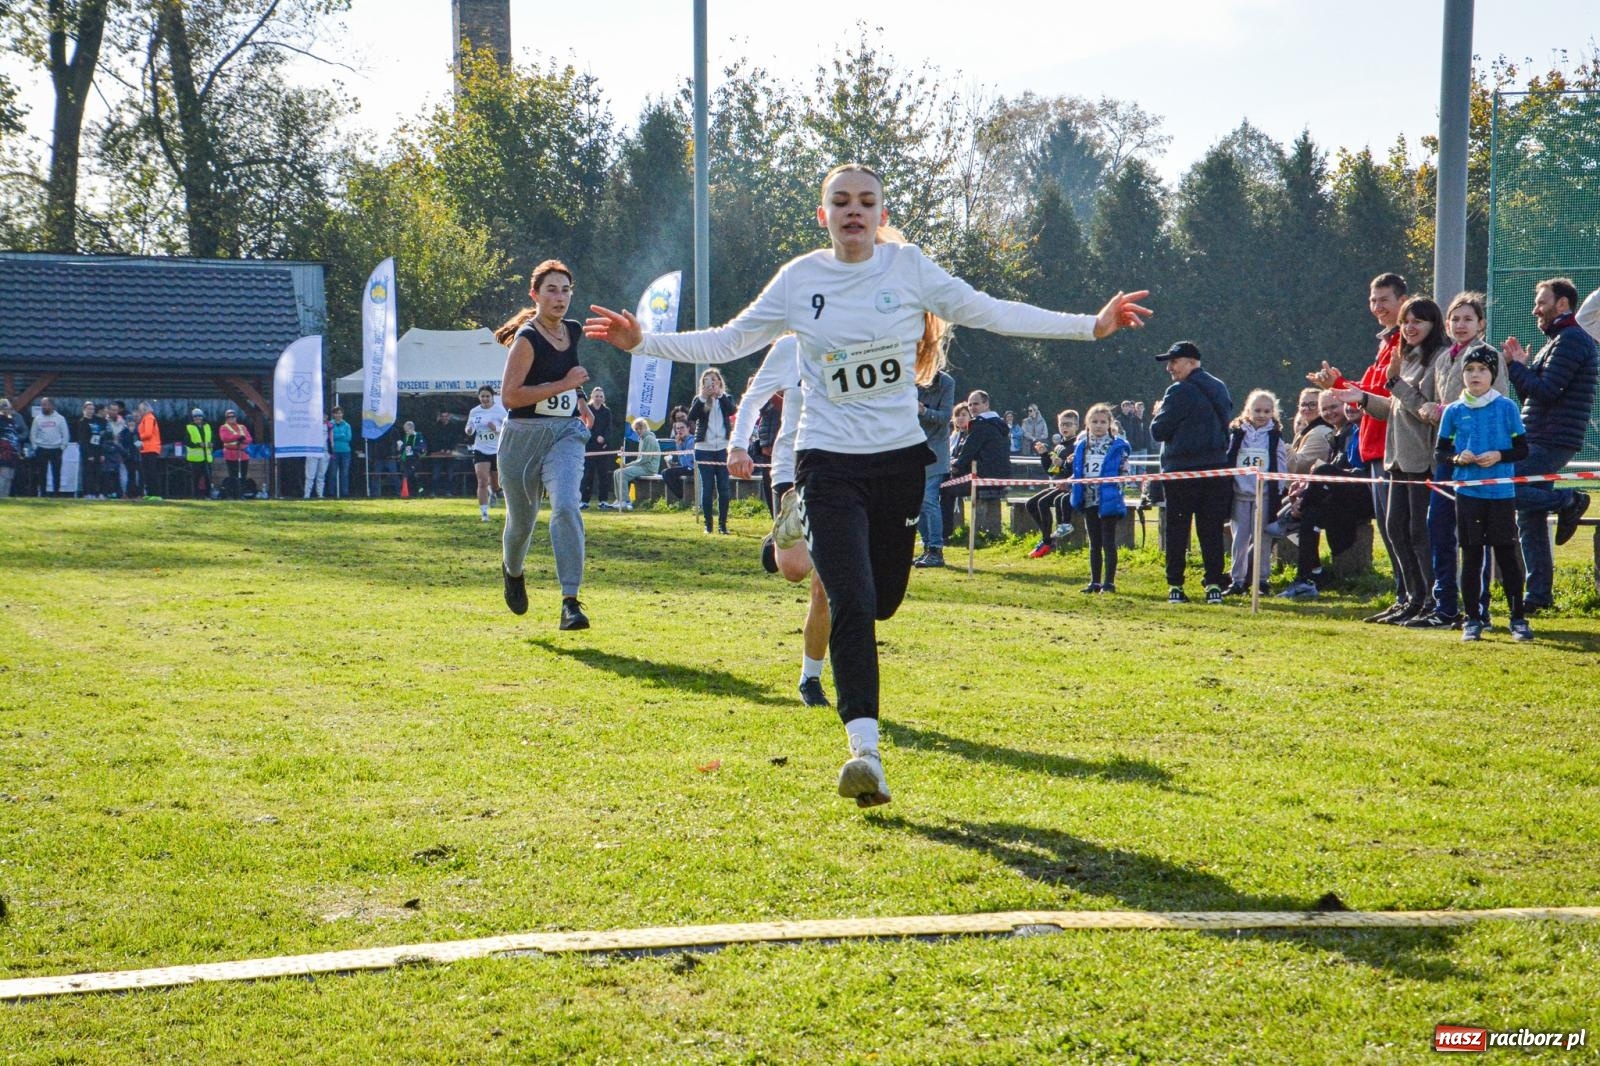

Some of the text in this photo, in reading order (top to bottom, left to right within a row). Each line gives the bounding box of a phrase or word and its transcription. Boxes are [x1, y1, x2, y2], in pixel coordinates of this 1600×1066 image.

[812, 294, 825, 320] 9
[832, 358, 901, 393] 109
[466, 380, 478, 389] DLA
[547, 395, 571, 410] 98
[479, 433, 495, 441] 110
